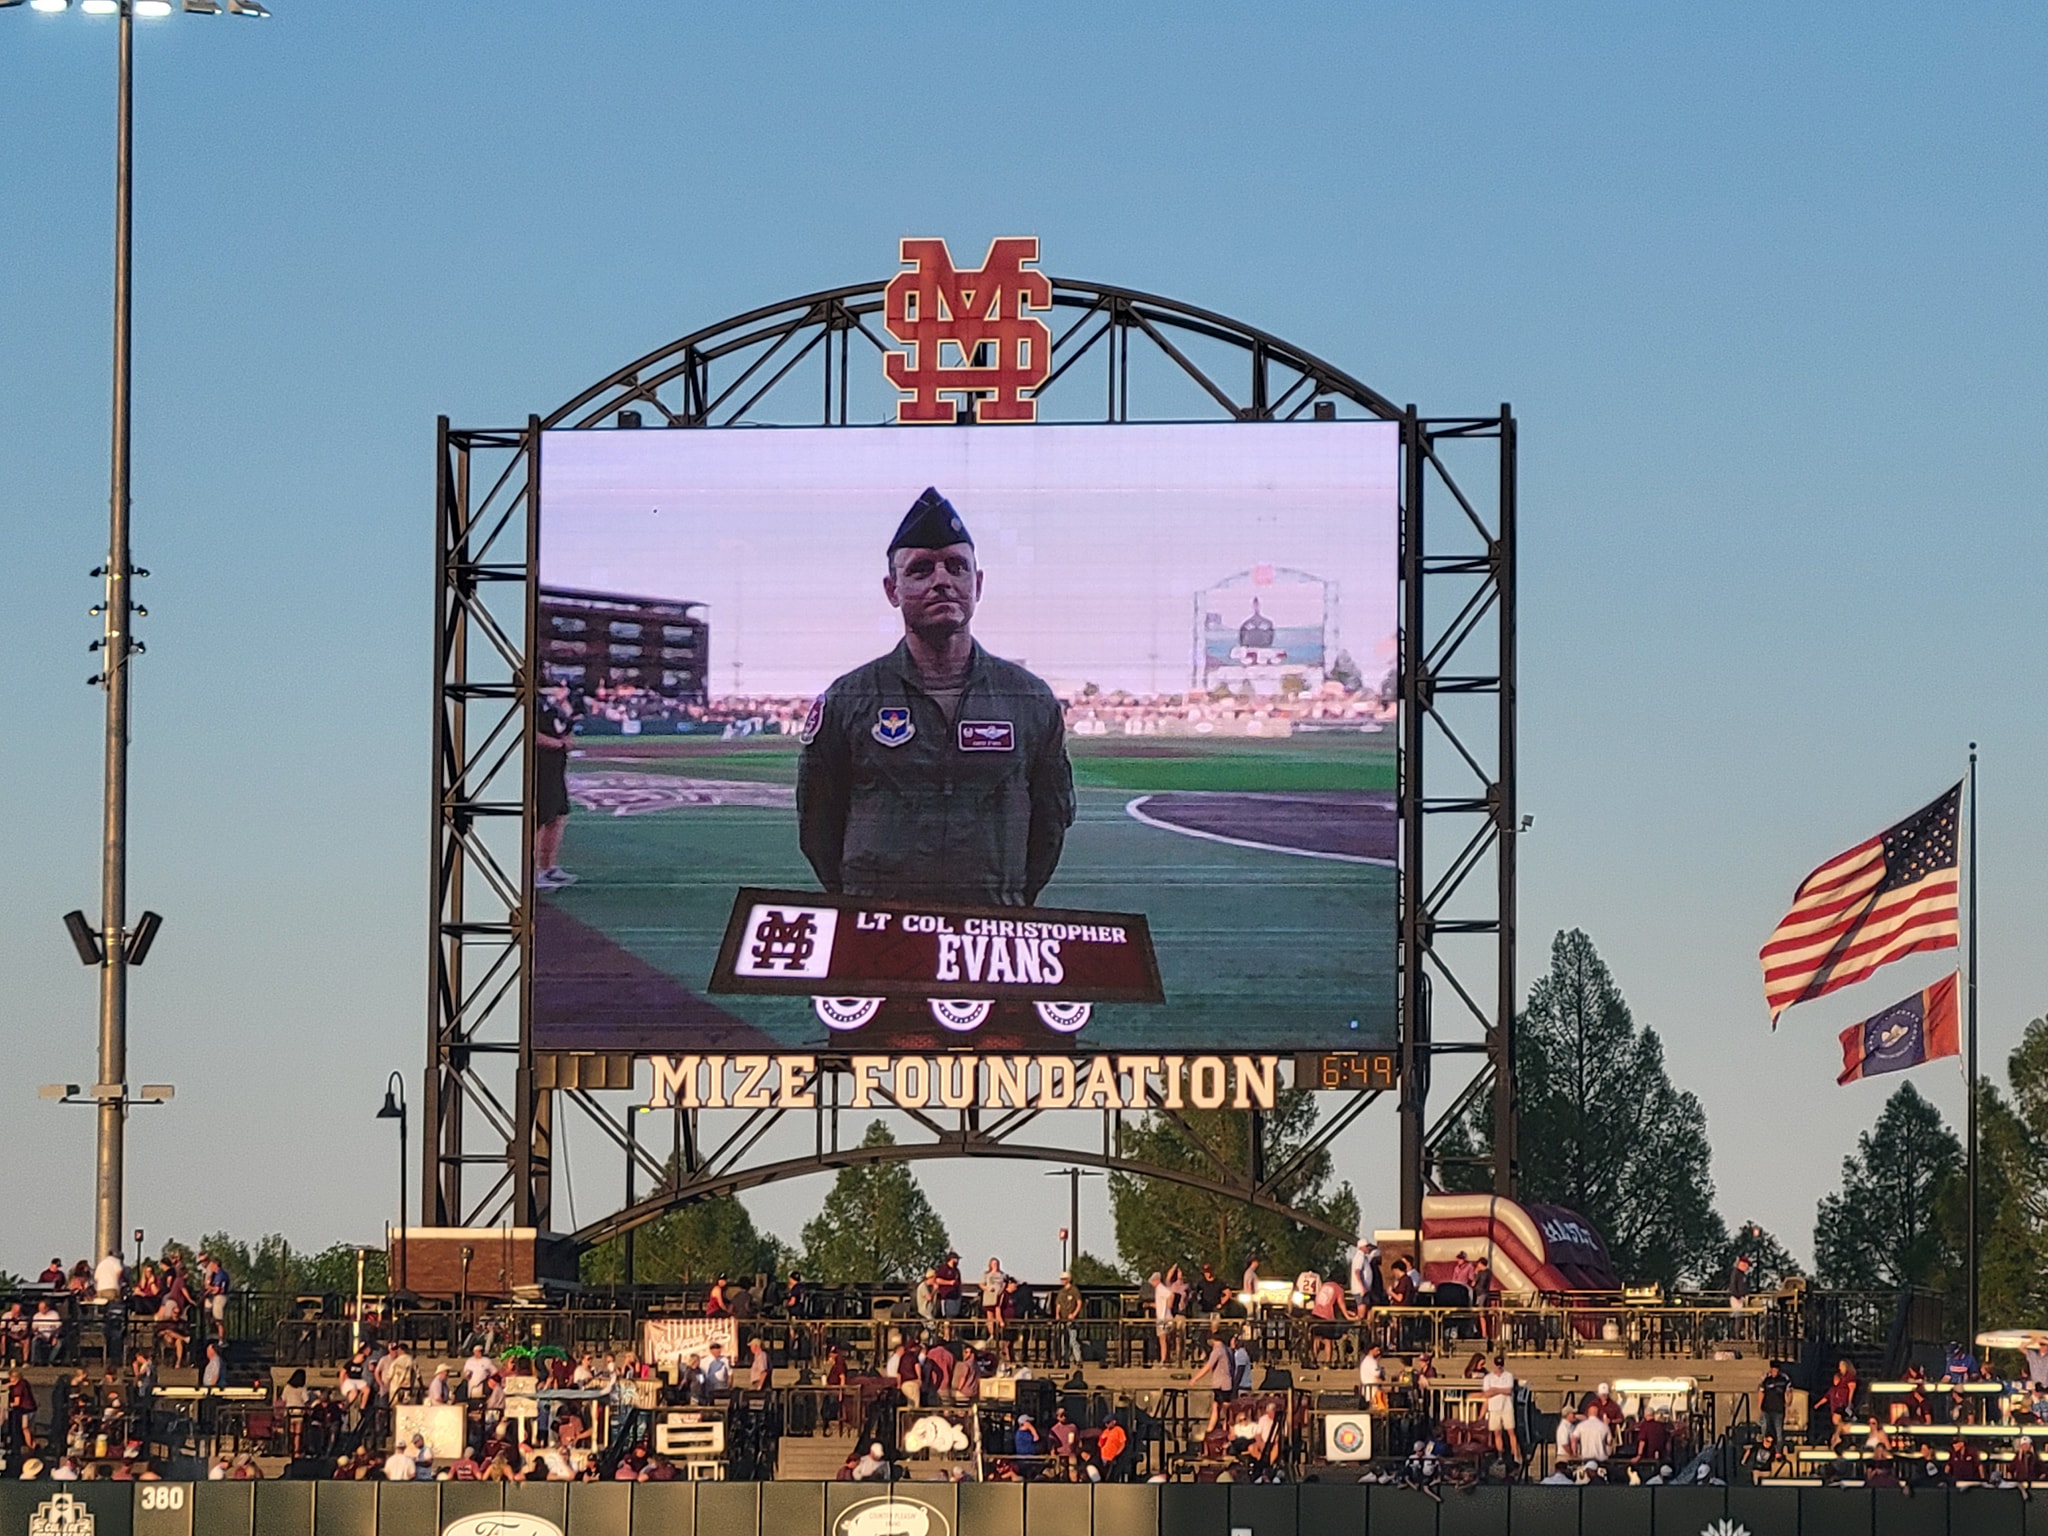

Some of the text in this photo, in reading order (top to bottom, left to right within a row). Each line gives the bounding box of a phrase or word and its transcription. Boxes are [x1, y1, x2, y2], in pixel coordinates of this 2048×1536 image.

[856, 911, 1127, 944] LT COL CHRISTOPHER
[936, 933, 1064, 985] EVANS
[649, 1054, 1279, 1109] MIZE FOUNDATION
[1322, 1055, 1392, 1086] 6:49
[141, 1486, 184, 1510] 380
